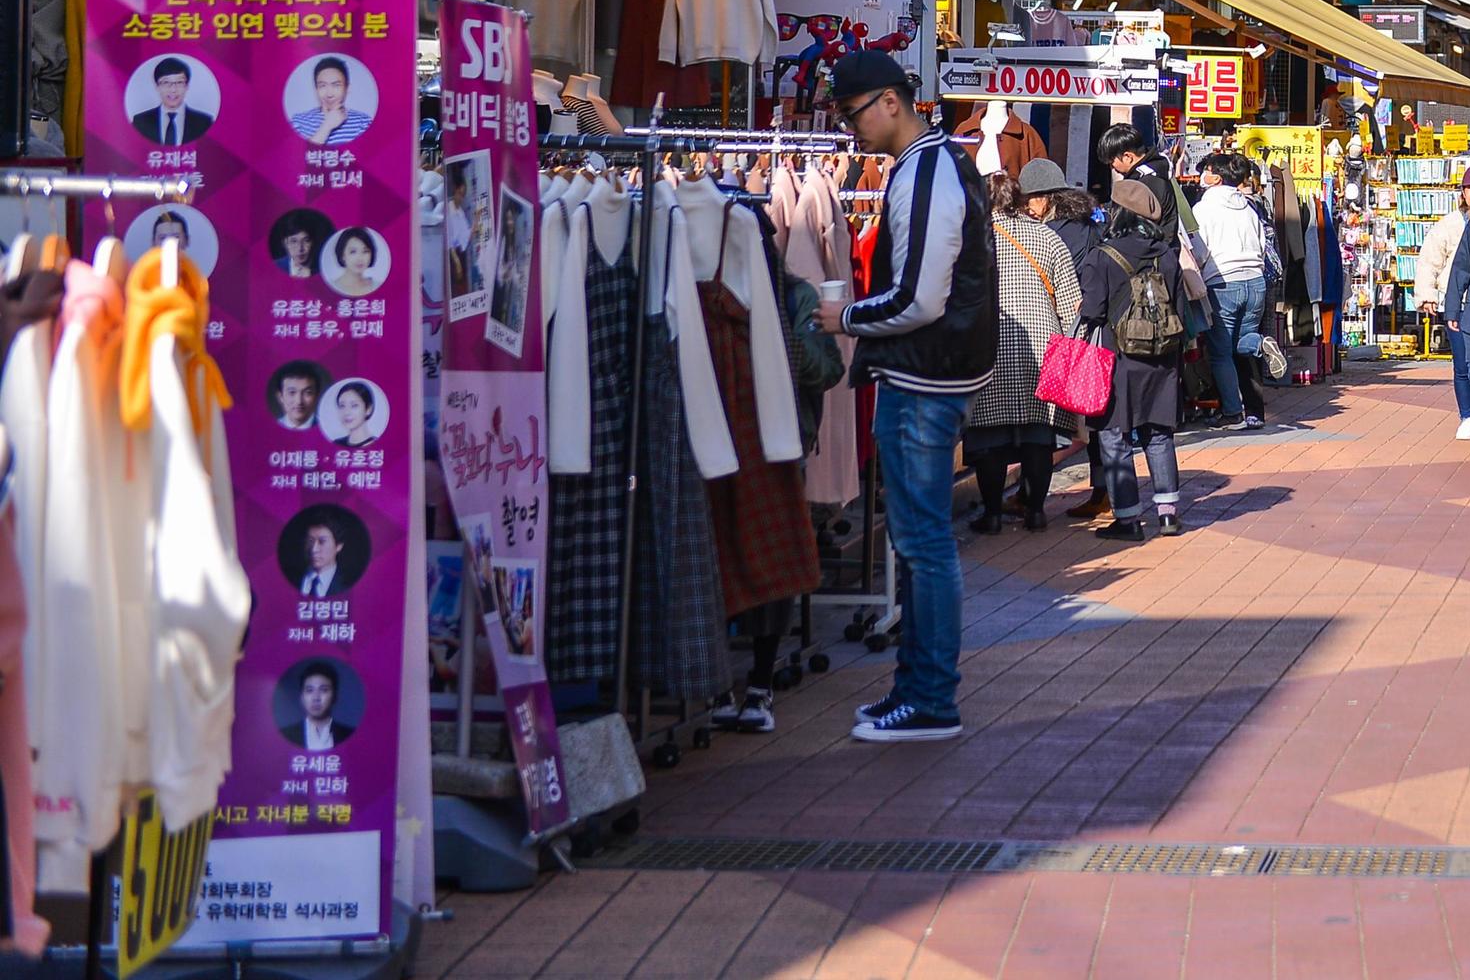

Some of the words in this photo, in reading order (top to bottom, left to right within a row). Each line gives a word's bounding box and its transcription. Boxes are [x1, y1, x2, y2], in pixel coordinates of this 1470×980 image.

[121, 11, 203, 40] 소중한
[212, 12, 264, 39] 인연
[273, 11, 353, 39] 맺으신
[361, 11, 390, 38] 분
[948, 75, 962, 84] Come
[963, 75, 981, 85] inside
[985, 67, 1071, 96] 10,000
[1073, 76, 1118, 96] WON
[1187, 60, 1239, 113] 필름
[146, 150, 197, 168] 유재석
[304, 149, 356, 168] 박명수
[297, 174, 324, 187] 자녀
[330, 171, 363, 188] 민서
[272, 300, 322, 317] 유준상
[274, 324, 300, 337] 자녀
[335, 450, 385, 468] 유호정
[272, 475, 297, 488] 자녀
[502, 495, 540, 547] 촬영
[298, 601, 349, 619] 김명민
[288, 627, 314, 641] 자녀
[320, 623, 356, 641] 재하
[291, 755, 341, 772] 유세윤
[282, 780, 308, 794] 자녀
[315, 777, 348, 794] 민하
[256, 806, 310, 823] 자녀분
[318, 805, 352, 823] 작명
[207, 902, 288, 921] 유학대학원
[295, 900, 359, 918] 석사과정
